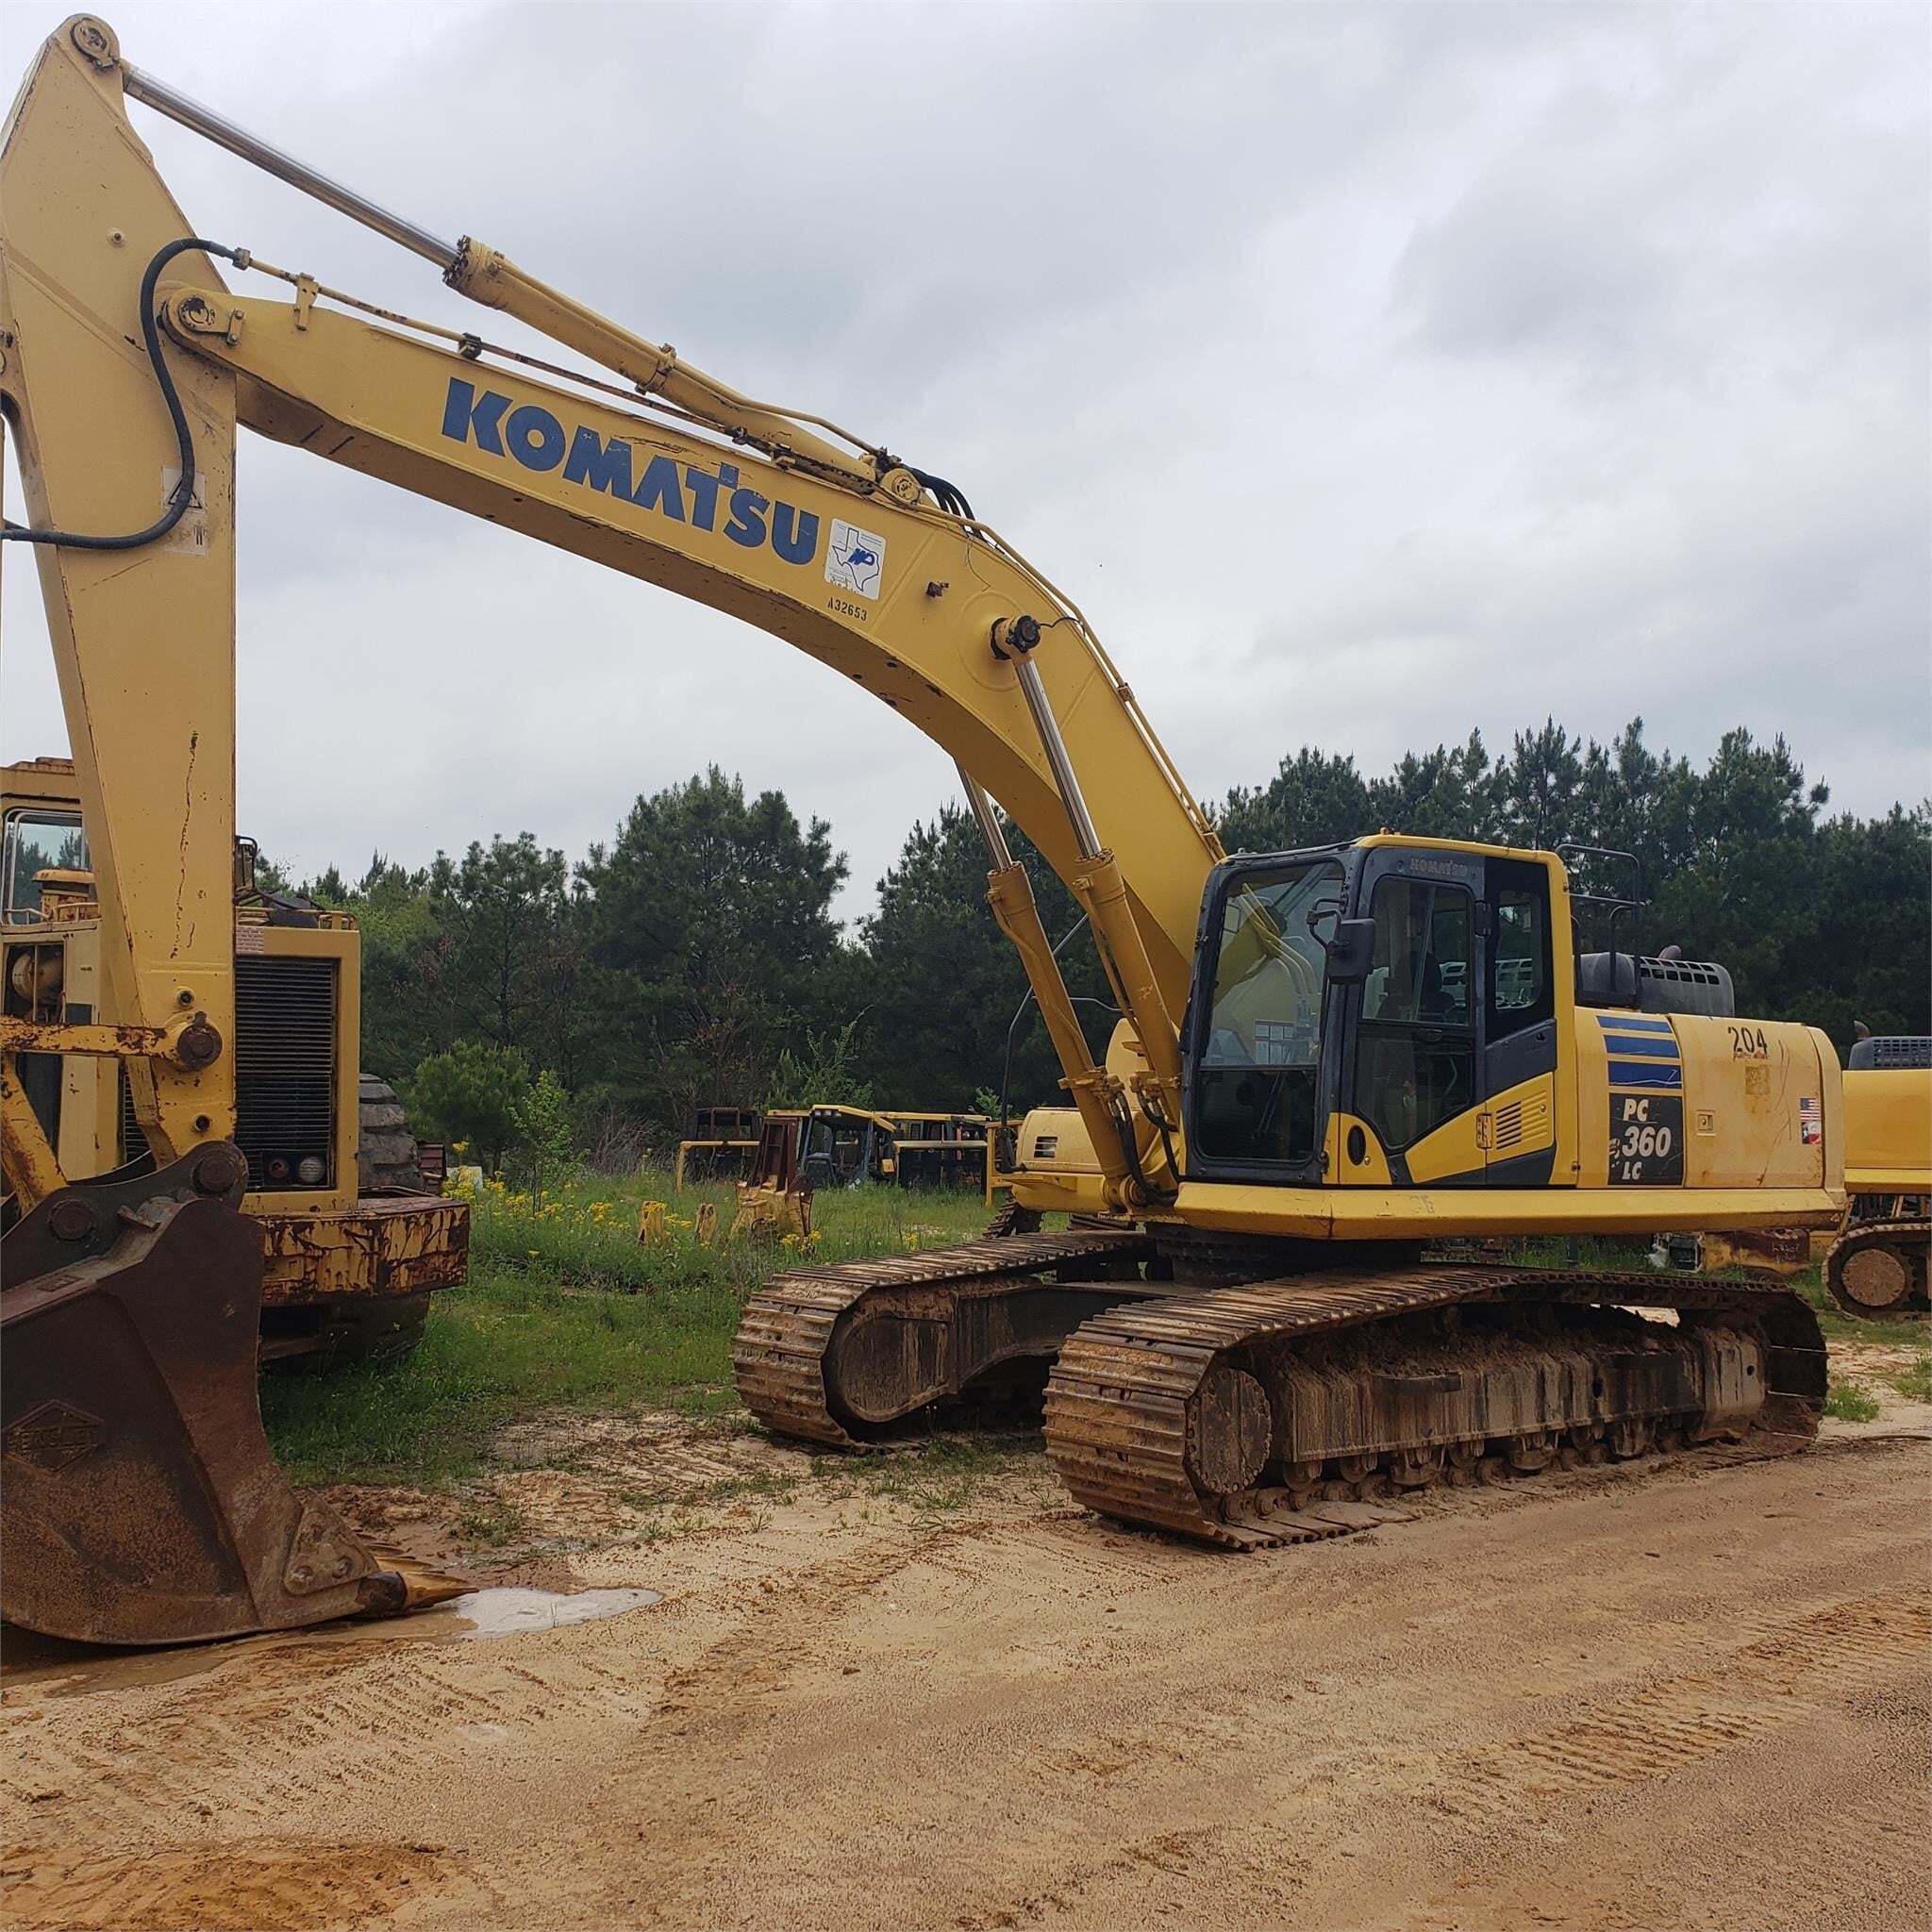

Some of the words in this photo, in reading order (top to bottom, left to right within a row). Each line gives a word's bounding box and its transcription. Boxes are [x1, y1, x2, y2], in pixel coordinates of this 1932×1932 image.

[441, 377, 820, 565] KOMATSU
[827, 597, 868, 622] A32653
[1727, 1026, 1767, 1055] 204
[1623, 1098, 1649, 1122] PC
[1622, 1125, 1672, 1158] 360
[1622, 1161, 1642, 1180] LC
